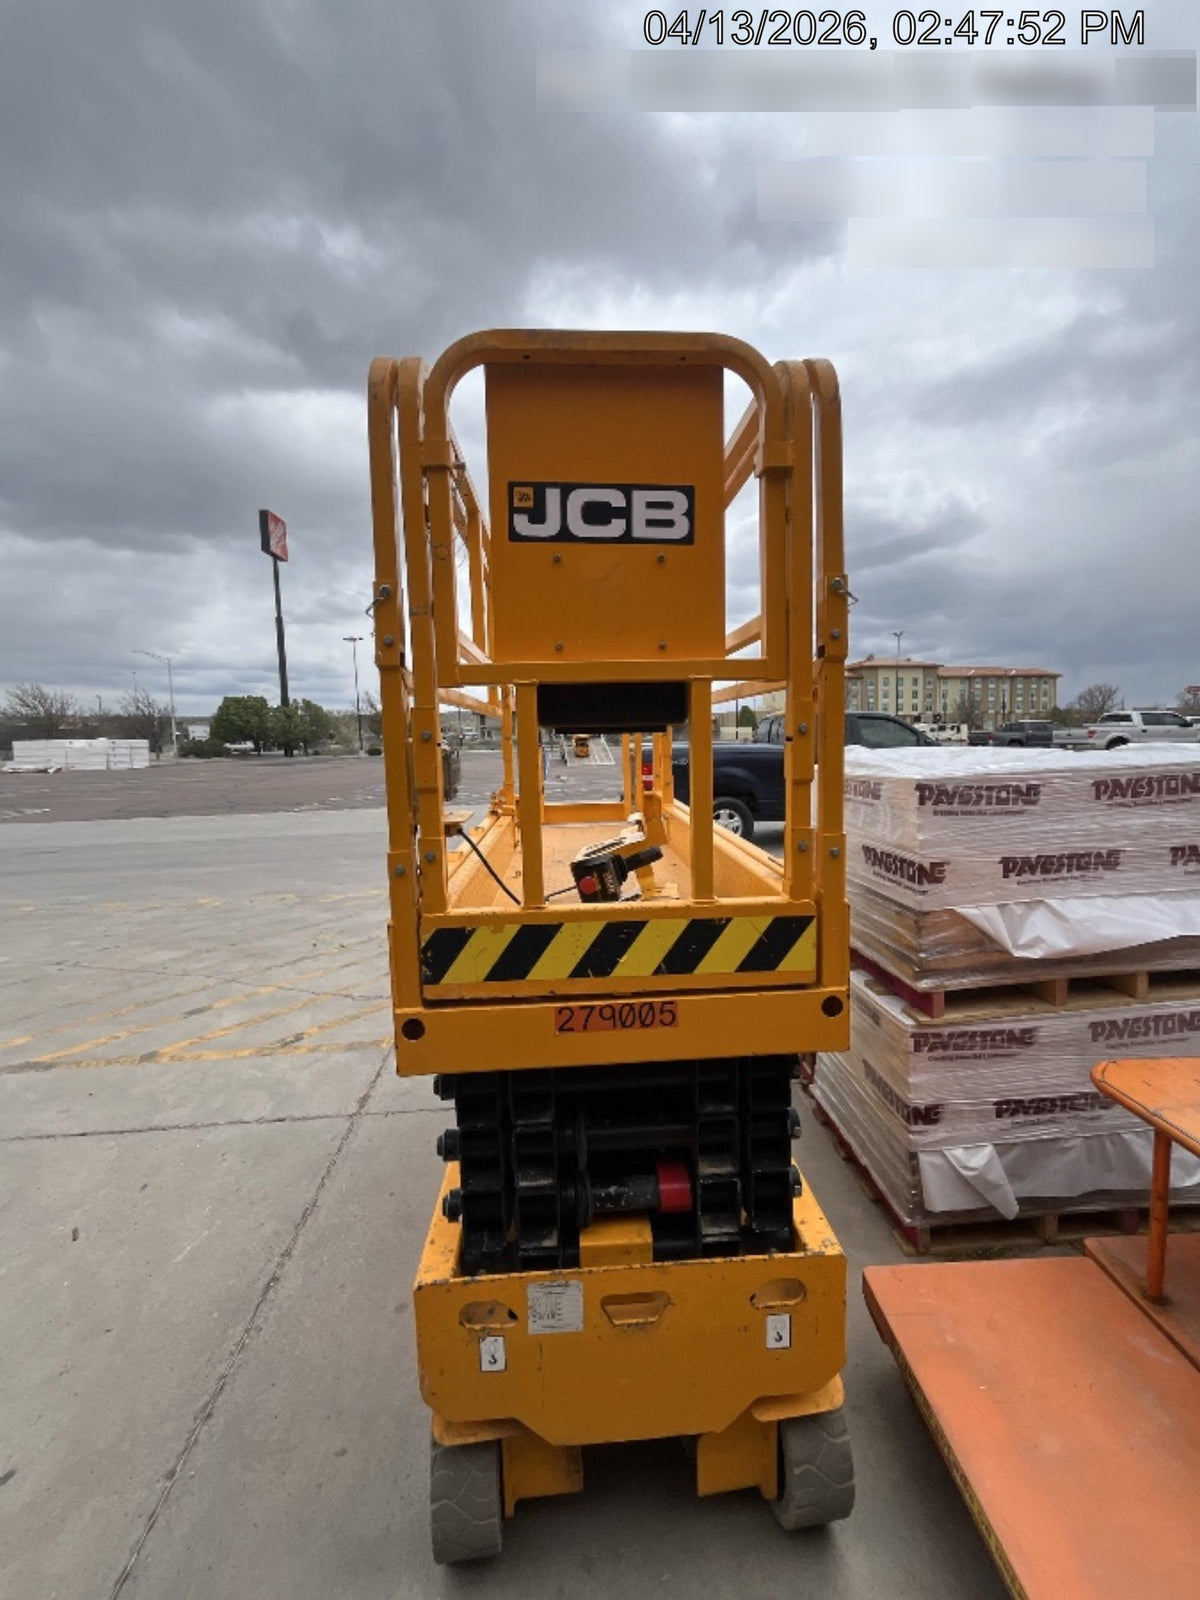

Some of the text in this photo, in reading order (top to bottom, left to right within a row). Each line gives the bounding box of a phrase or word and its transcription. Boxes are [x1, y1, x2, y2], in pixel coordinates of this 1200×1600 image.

[513, 487, 690, 540] JCB
[861, 844, 950, 886] PAVESTONE
[998, 849, 1126, 879] PAVESTONE
[557, 1001, 677, 1032] 279005
